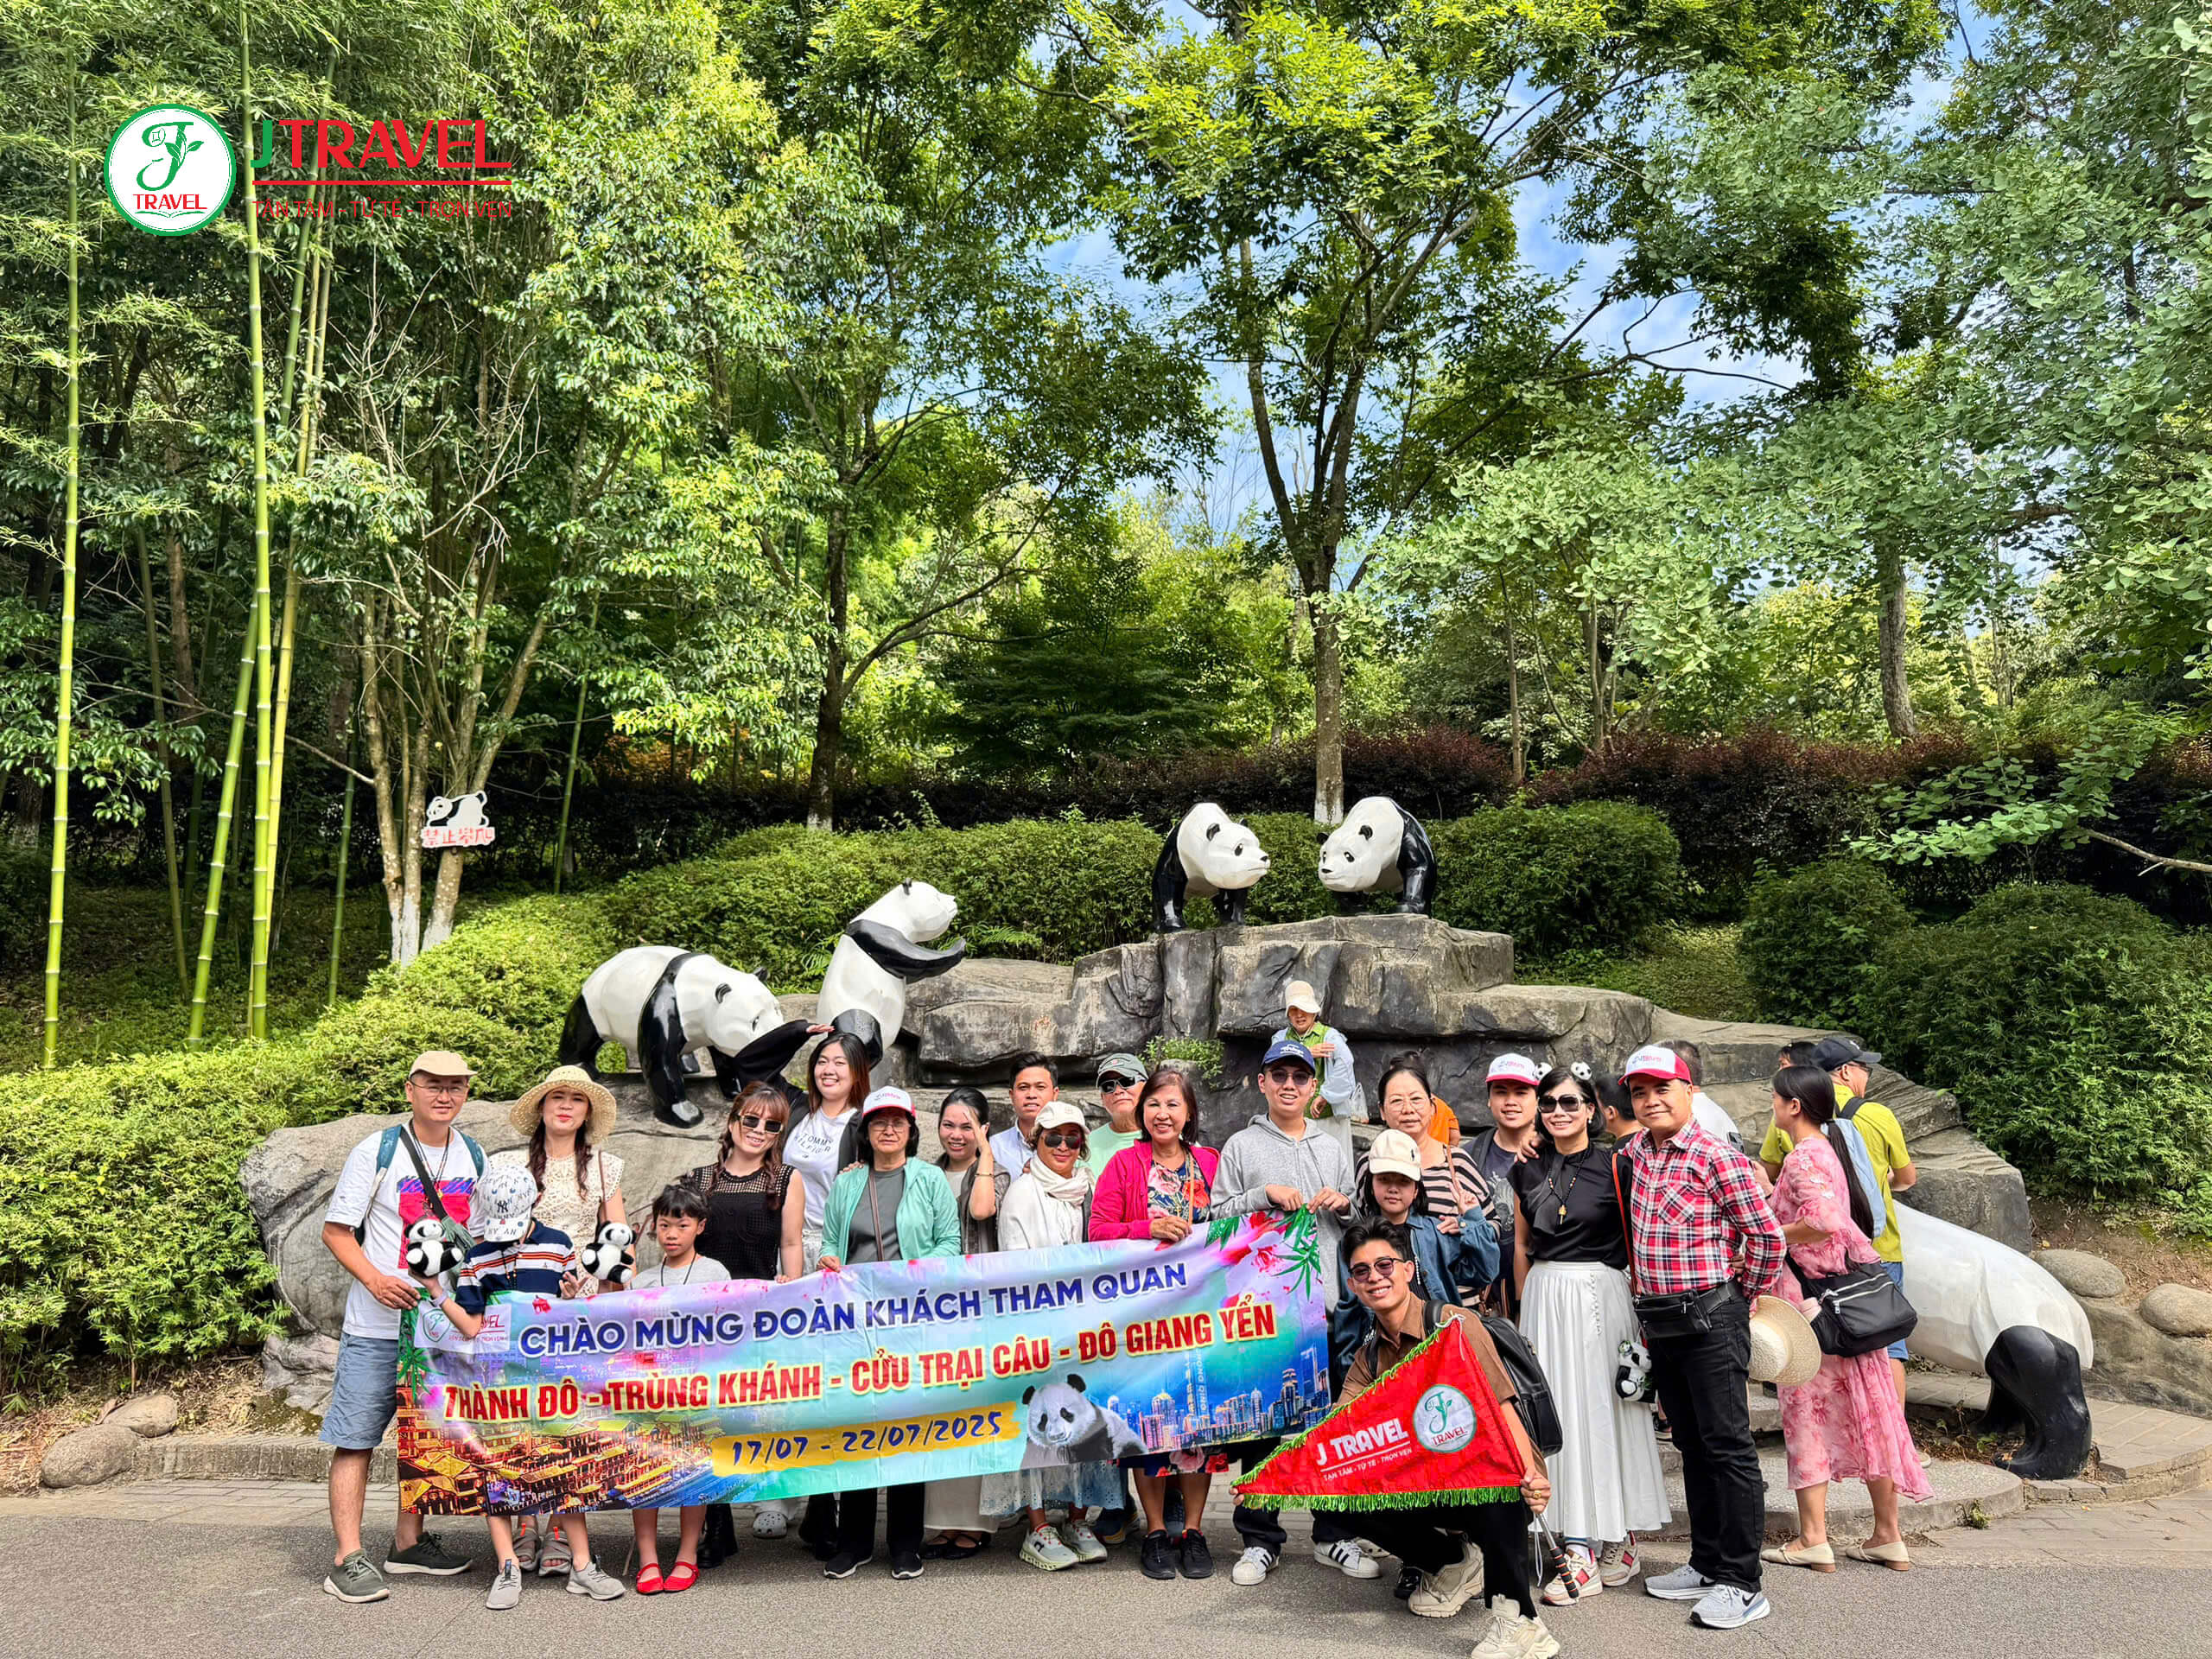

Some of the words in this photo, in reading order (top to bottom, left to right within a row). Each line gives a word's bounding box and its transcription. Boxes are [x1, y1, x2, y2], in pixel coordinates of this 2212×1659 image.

[521, 1318, 625, 1354] CHÀO
[636, 1311, 744, 1348] MỪNG
[753, 1300, 855, 1339] ĐOÀN
[866, 1288, 982, 1326] KHÁCH
[988, 1278, 1084, 1314] THAM
[1093, 1262, 1186, 1297] QUAN
[445, 1384, 530, 1421] THÀNH
[537, 1378, 579, 1418] ĐÔ
[608, 1372, 709, 1411] TRÙNG
[719, 1363, 821, 1405] KHÁNH
[852, 1348, 910, 1391] CỬU
[918, 1348, 984, 1387] TRẠI
[993, 1336, 1051, 1376] CÂU
[1078, 1322, 1116, 1362] ĐÔ
[1126, 1313, 1211, 1355] GIANG
[1219, 1294, 1275, 1339] YỂN
[733, 1436, 809, 1465] 17/07
[842, 1410, 1002, 1452] 22/07/2025
[1316, 1442, 1328, 1466] J
[1330, 1418, 1409, 1460] TRAVEL
[1432, 1426, 1468, 1446] TRAVEL
